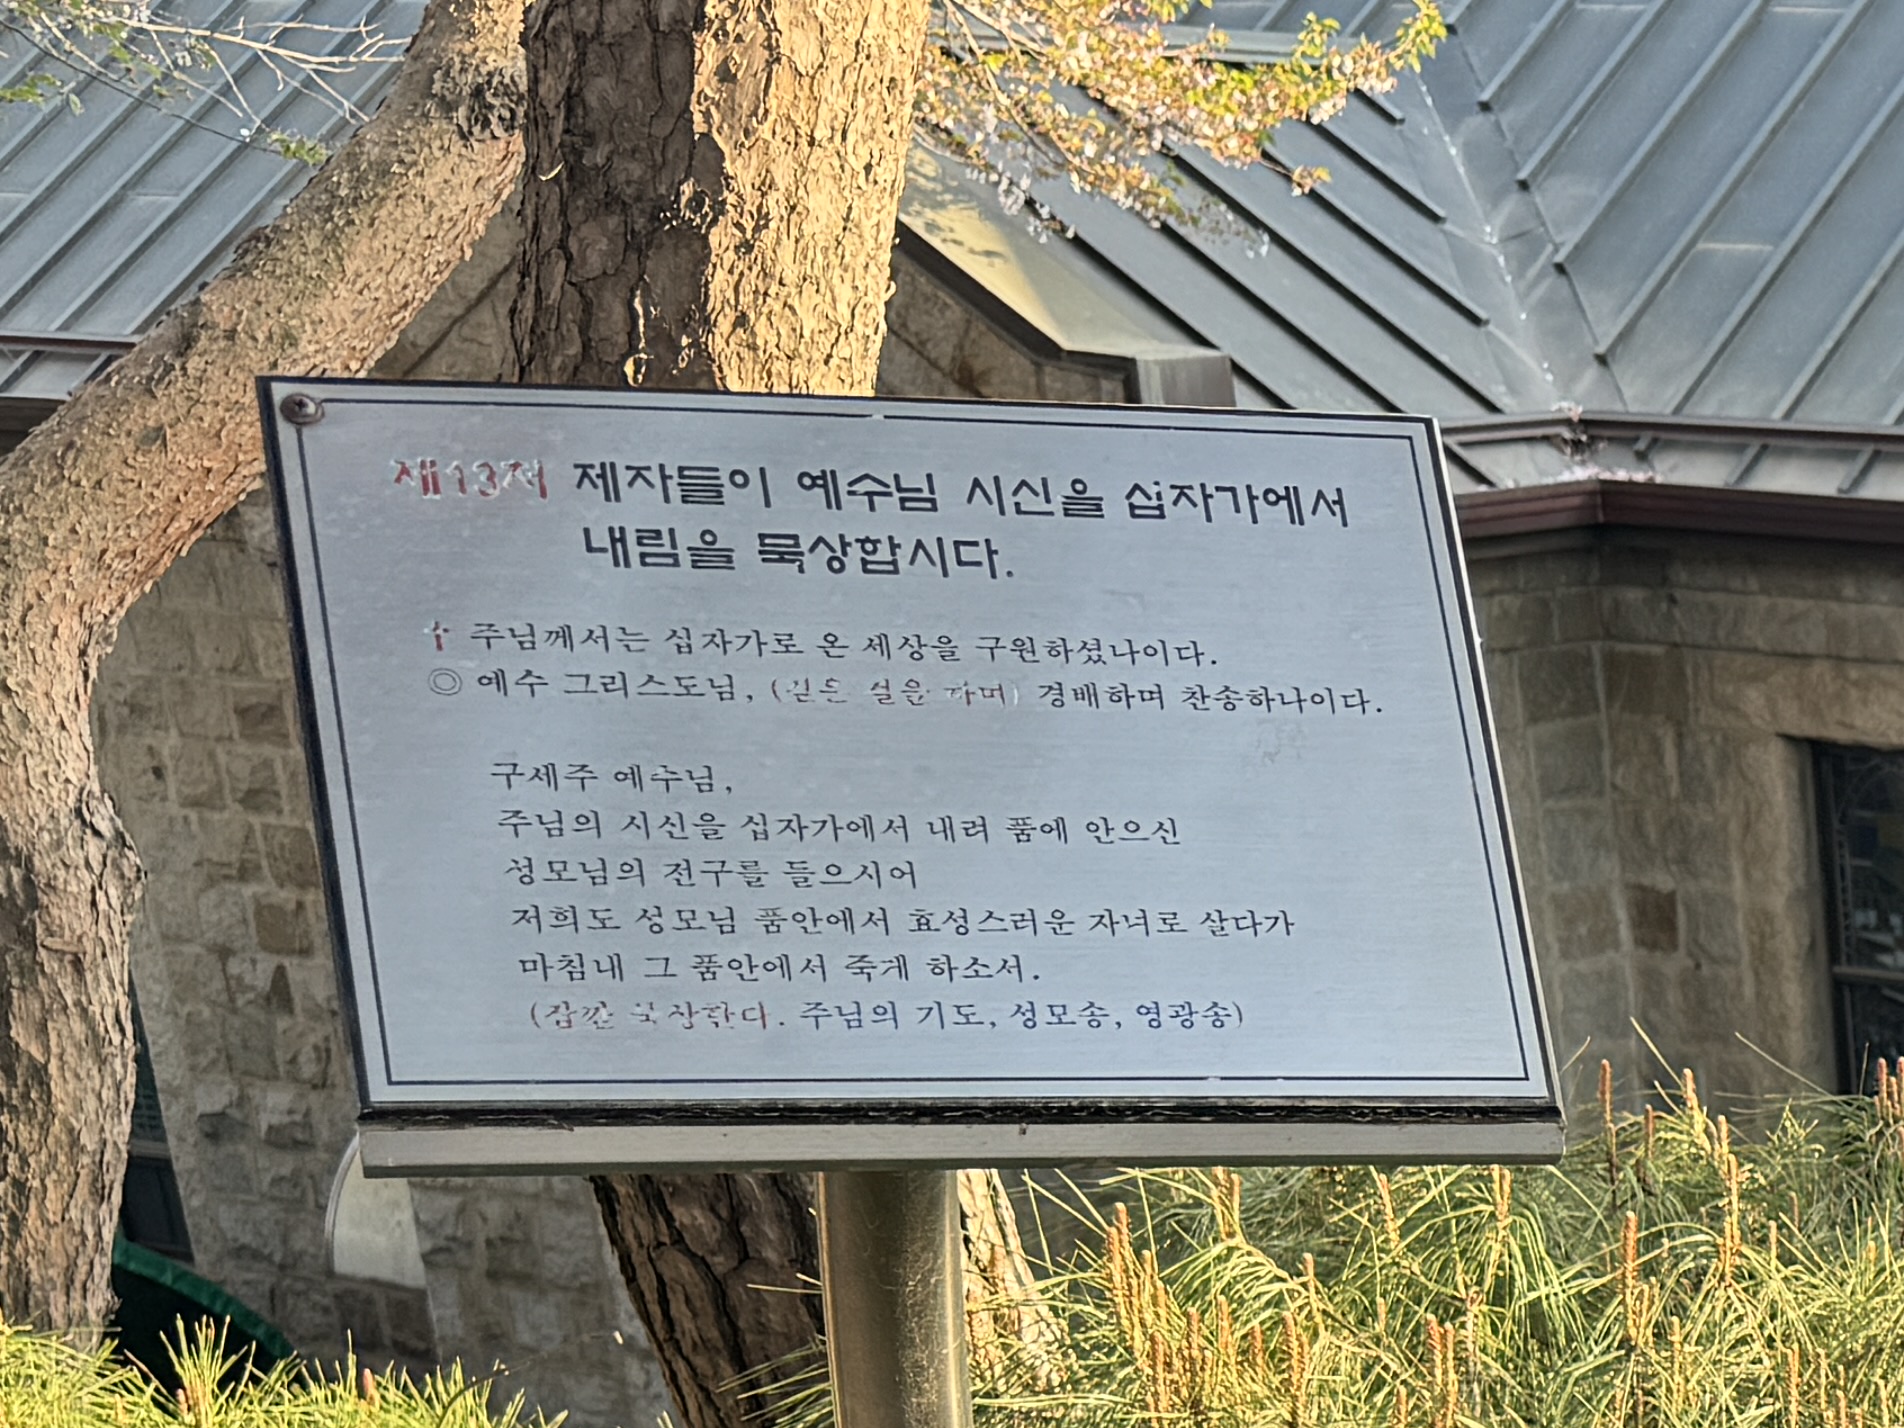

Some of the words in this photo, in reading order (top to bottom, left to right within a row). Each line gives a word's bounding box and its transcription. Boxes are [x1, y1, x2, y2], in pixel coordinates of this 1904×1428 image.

[572, 460, 772, 509] 제자들이
[796, 468, 939, 513] 예수님
[966, 474, 1106, 520] 시신을
[1124, 480, 1349, 529] 십자가에서
[582, 525, 736, 571] 내림을
[756, 532, 1014, 580] 묵상합시다.
[469, 622, 651, 654] 주님께서는
[664, 626, 805, 659] 십자가로
[815, 631, 850, 659] 온
[861, 632, 961, 662] 세상을
[974, 635, 1218, 668] 구원하셨나이다.
[476, 667, 550, 699] 예수
[563, 670, 754, 704] 그리스도님,
[1037, 681, 1165, 711] 경배하며
[1181, 683, 1383, 716] 찬송하나이다.
[489, 762, 599, 793] 구세주
[613, 763, 733, 795] 예수님,
[497, 809, 602, 840] 주님의
[620, 810, 727, 841] 시신을
[740, 812, 909, 844] 십자가에서
[925, 814, 989, 845] 내려
[1005, 816, 1069, 845] 품에
[1085, 816, 1181, 846] 안으신
[504, 855, 646, 888] 성모님의
[663, 857, 770, 889] 전구를
[782, 860, 917, 890] 들으시어
[511, 903, 622, 935] 저희도
[634, 904, 736, 936] 성모님
[753, 906, 890, 937] 품안에서
[907, 906, 1076, 937] 효성스러운
[1088, 908, 1189, 938] 자녀로
[1199, 908, 1296, 939] 살다가
[518, 951, 624, 983] 마침내
[643, 956, 678, 978] 그
[689, 952, 827, 984] 품안에서
[844, 953, 910, 984] 죽게
[925, 953, 1040, 984] 하소서.
[799, 1000, 899, 1031] 주님의
[915, 1000, 997, 1031] 기도,
[1009, 1000, 1122, 1030] 성모송,
[1135, 1000, 1244, 1030] 영광송)
